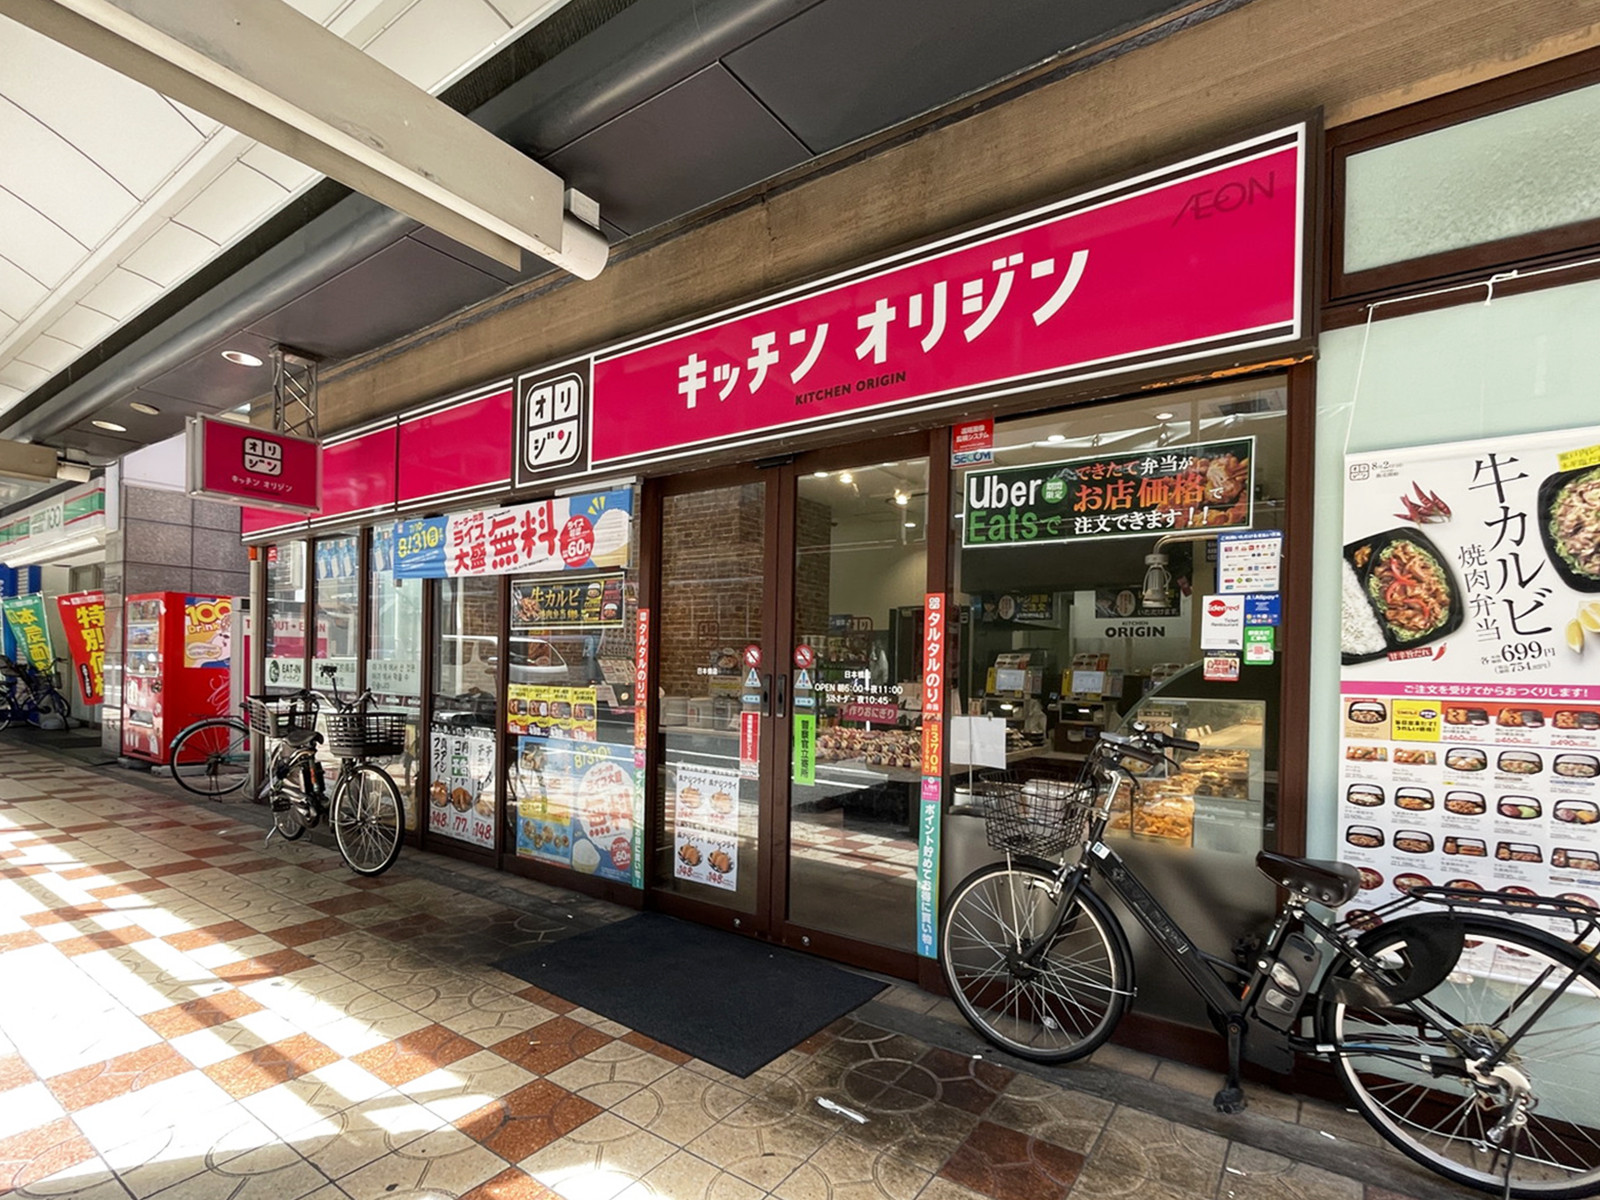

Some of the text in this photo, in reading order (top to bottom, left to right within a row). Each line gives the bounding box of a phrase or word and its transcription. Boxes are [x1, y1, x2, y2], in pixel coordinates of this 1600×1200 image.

[678, 250, 1089, 409] キッチン オリジン
[795, 371, 906, 406] KITCHEN ORIGIN
[953, 451, 991, 464] SECOM
[1075, 456, 1193, 481] できたて弁当が
[970, 475, 1042, 509] Uber
[453, 523, 486, 547] ライス
[488, 499, 558, 570] 無料
[1468, 453, 1553, 636] 牛カルビ
[454, 541, 487, 575] 大盛
[530, 586, 580, 607] 牛カルビ
[1458, 544, 1501, 642] 焼肉弁当
[1105, 626, 1166, 638] ORIGIN
[815, 683, 836, 692] OPEN
